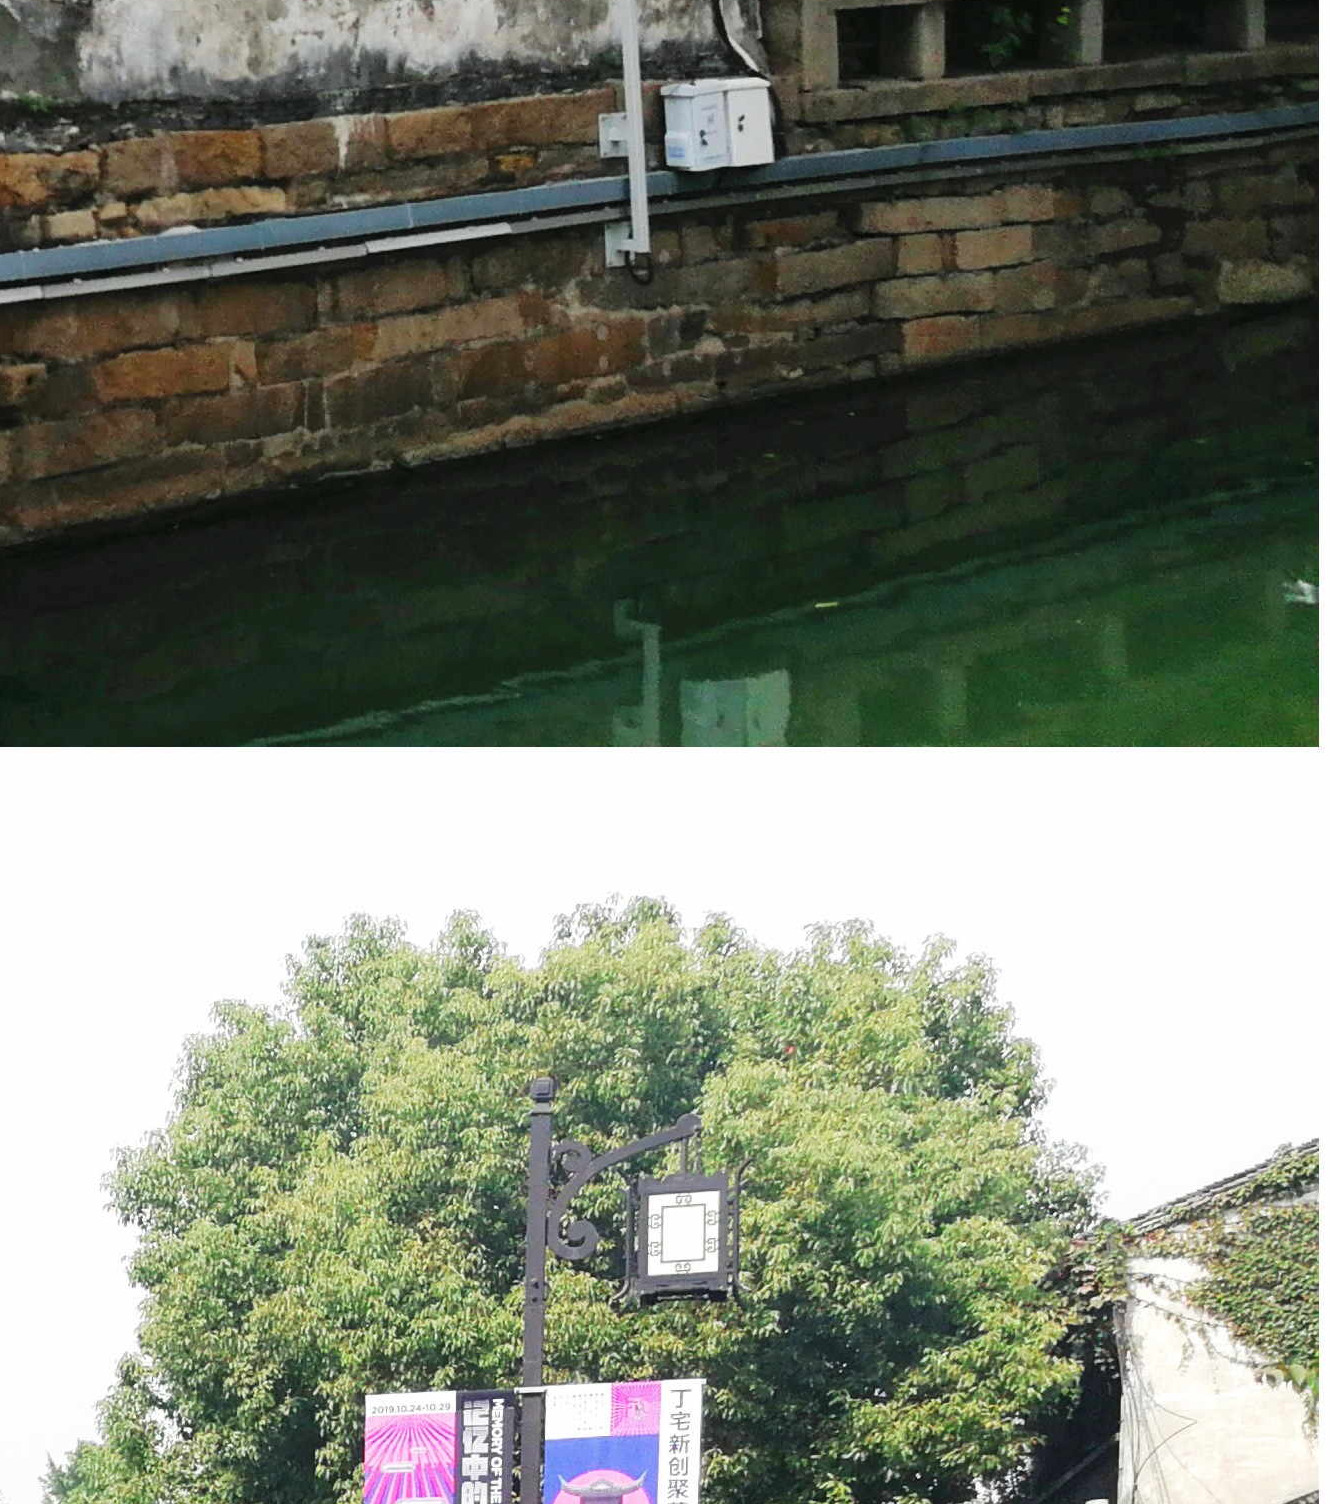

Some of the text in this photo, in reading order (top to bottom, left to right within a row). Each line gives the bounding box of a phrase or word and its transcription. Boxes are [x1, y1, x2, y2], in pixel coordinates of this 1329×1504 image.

[371, 1402, 451, 1414] 2019.10.24-10.29
[490, 1398, 505, 1455] MEMORY
[490, 1457, 503, 1478] OF
